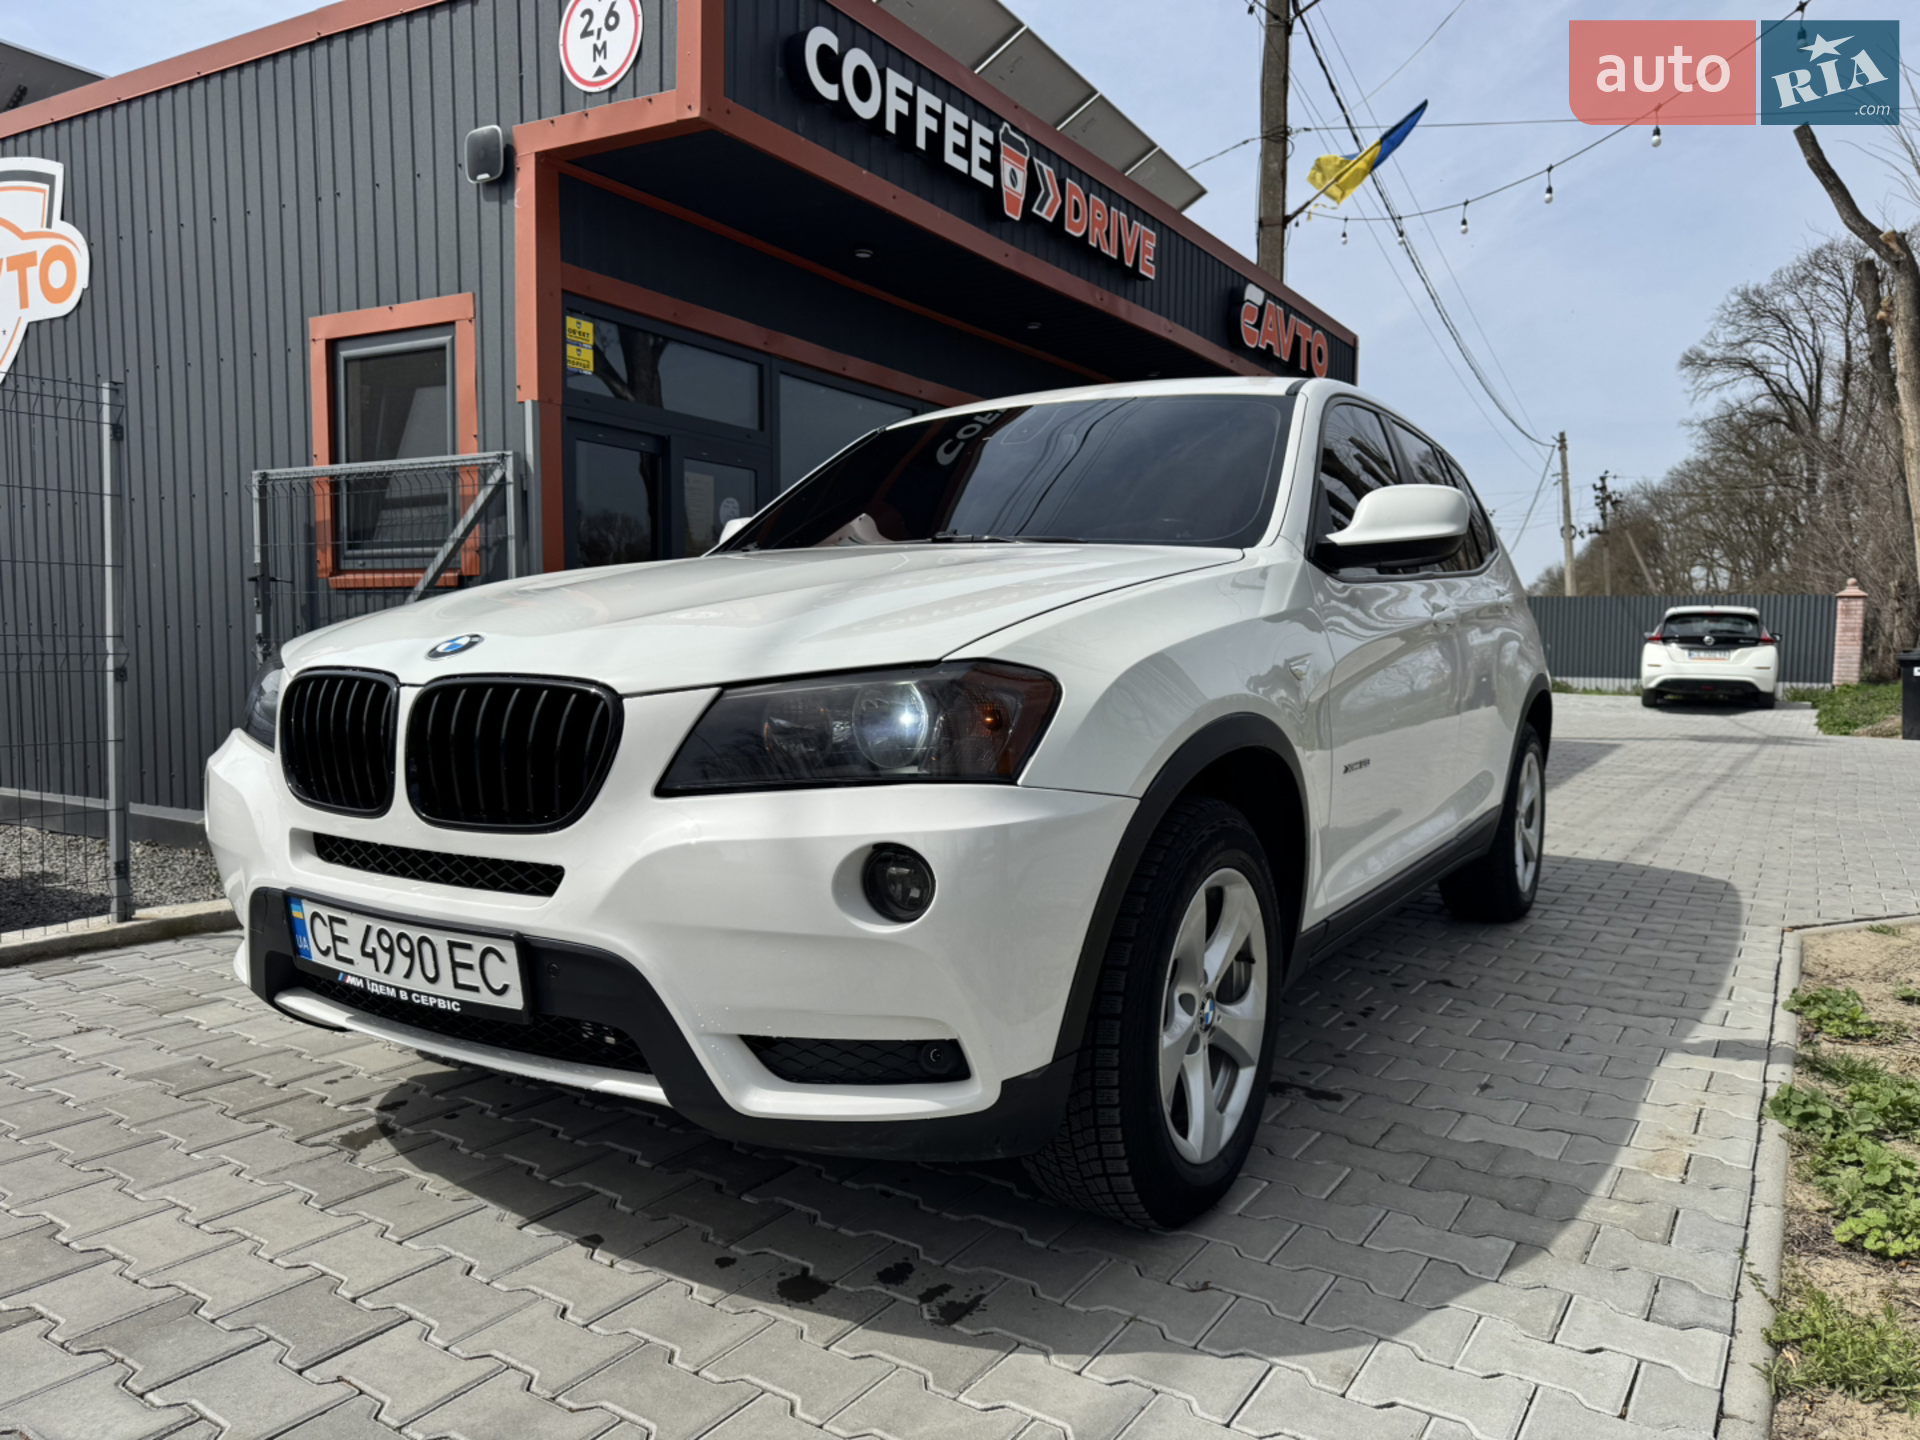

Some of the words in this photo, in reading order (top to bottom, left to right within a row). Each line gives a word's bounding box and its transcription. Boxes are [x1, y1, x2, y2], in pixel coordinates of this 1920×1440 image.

[579, 0, 620, 41] 2,6
[804, 25, 994, 189] COFFEE
[1064, 177, 1156, 280] DRIVE
[0, 244, 78, 310] TO
[295, 934, 310, 951] UA
[309, 910, 355, 967] CE
[360, 923, 440, 984] 4990
[447, 940, 511, 996] EC
[411, 992, 461, 1012] СЕРВІС
